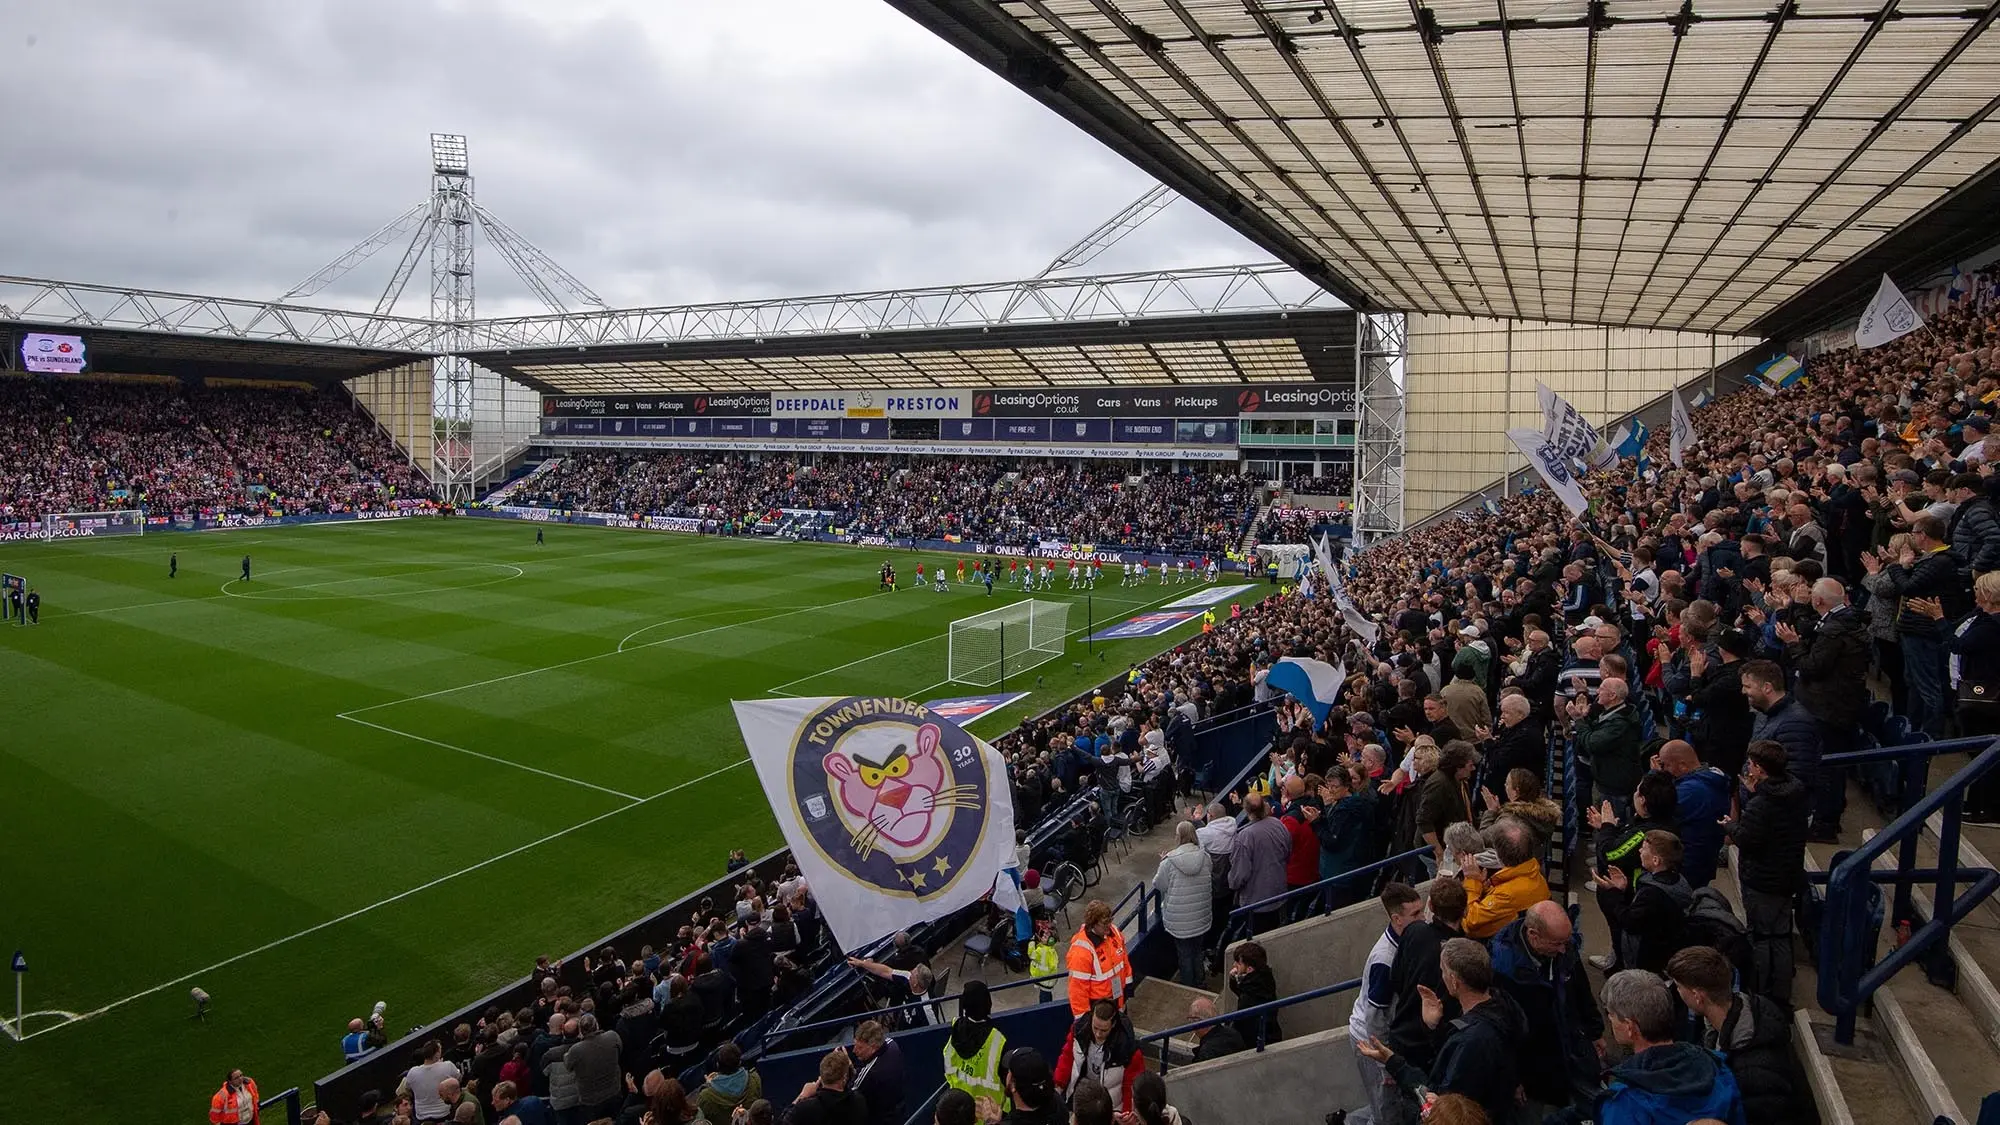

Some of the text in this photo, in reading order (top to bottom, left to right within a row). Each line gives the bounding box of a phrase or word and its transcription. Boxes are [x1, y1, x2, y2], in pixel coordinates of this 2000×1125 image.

[709, 396, 770, 408] LeasingOptions
[994, 393, 1079, 408] LeasingOptions
[1097, 398, 1120, 407] Cars
[1134, 398, 1161, 407] Vans
[1175, 397, 1218, 409] Pickups
[1265, 389, 1356, 405] LeasingOptio
[556, 398, 606, 410] LeasingOptions
[658, 401, 684, 411] Pickups
[776, 399, 844, 410] DEEPDALE
[887, 397, 958, 410] PRESTON
[995, 546, 1025, 556] ONLINE
[1042, 549, 1122, 563] PAR-GROUP.CO.UK
[808, 698, 929, 746] TOWNENDER
[953, 746, 972, 761] 30
[958, 757, 975, 769] YEARS
